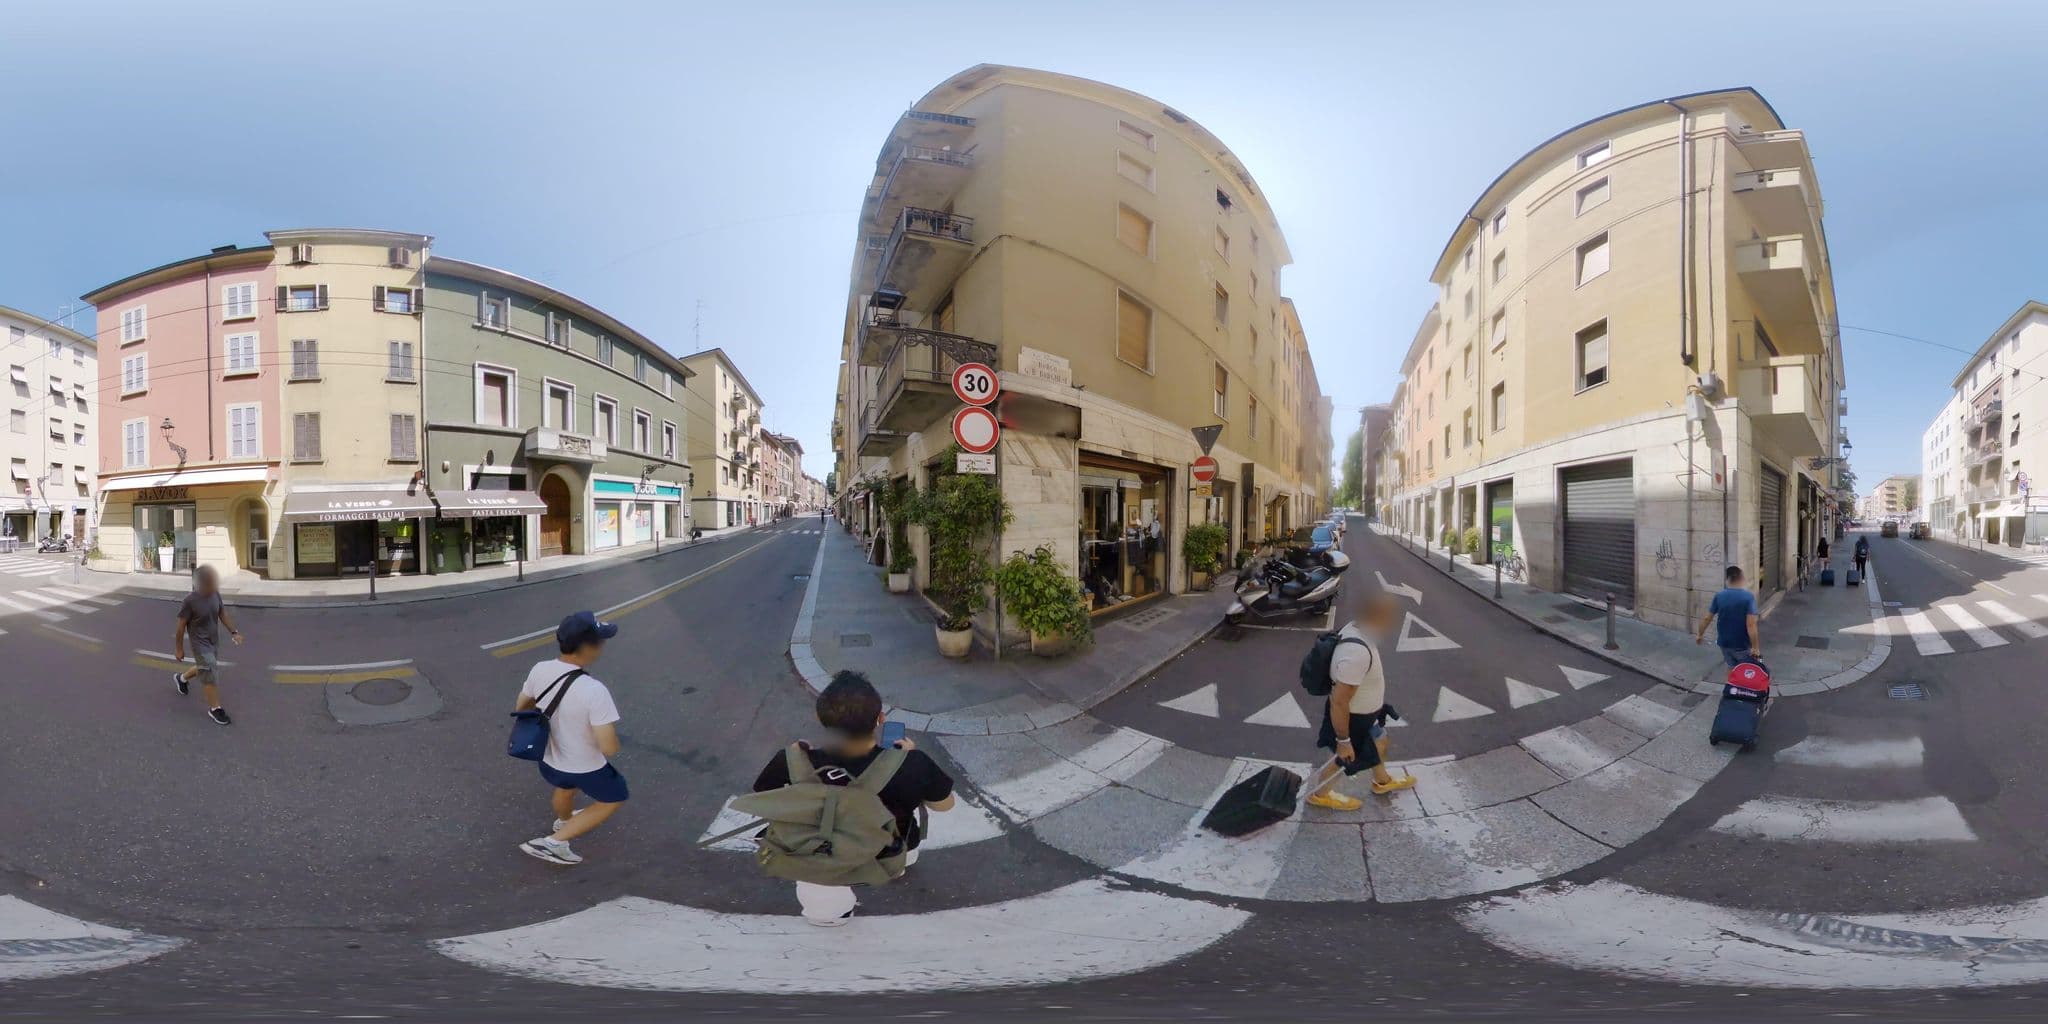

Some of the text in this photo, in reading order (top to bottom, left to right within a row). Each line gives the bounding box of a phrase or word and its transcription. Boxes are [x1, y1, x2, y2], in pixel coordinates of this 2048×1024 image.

[964, 373, 989, 394] 30
[319, 511, 405, 521] FORMAGGI SALUMI
